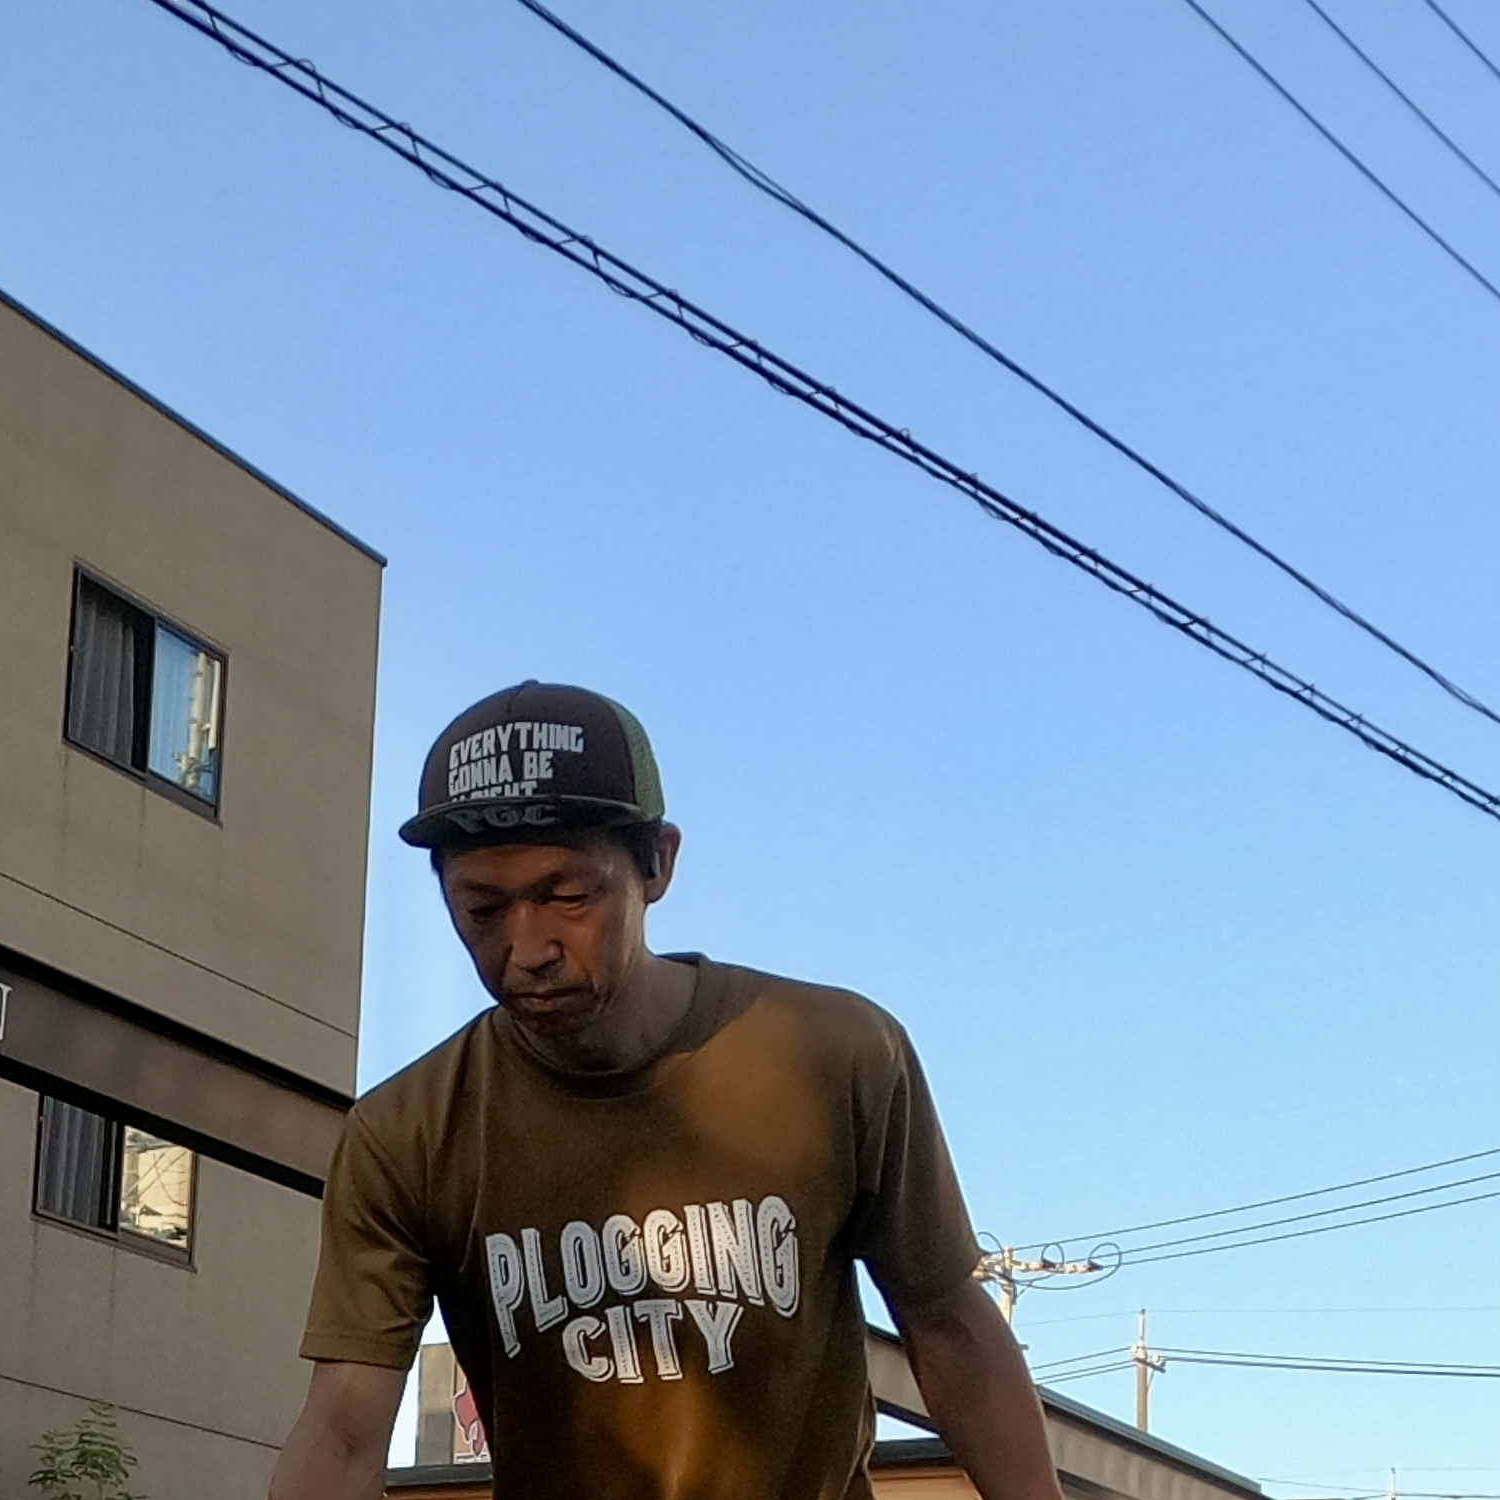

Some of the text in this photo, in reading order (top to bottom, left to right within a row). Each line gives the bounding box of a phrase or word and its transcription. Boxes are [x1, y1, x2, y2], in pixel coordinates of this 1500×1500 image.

[448, 754, 514, 796] GONNA
[523, 751, 554, 781] BE
[450, 721, 585, 770] EVERYTHING
[484, 1194, 800, 1359] PLOGGING
[561, 1298, 745, 1385] CITY
